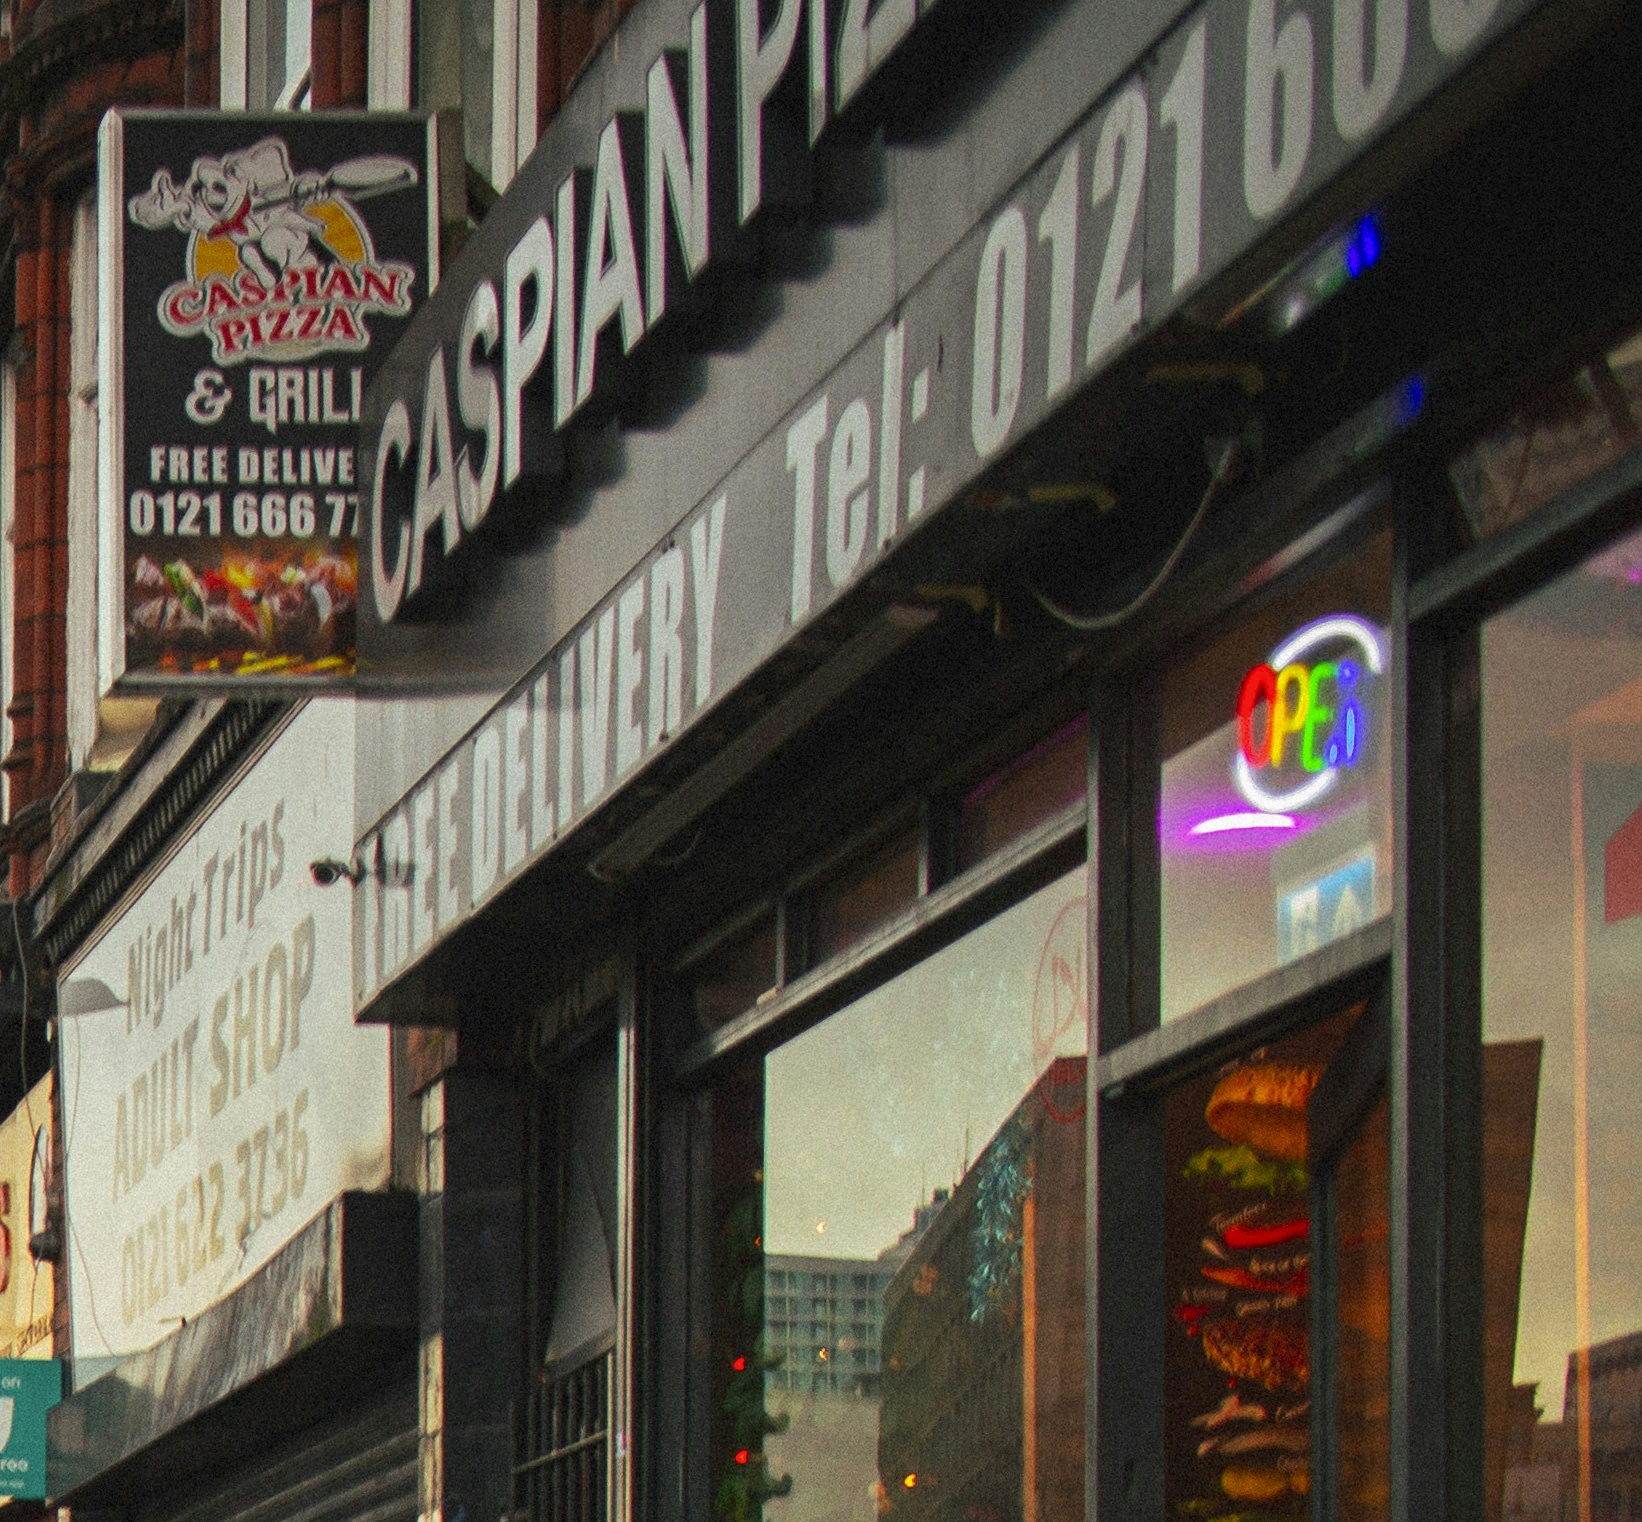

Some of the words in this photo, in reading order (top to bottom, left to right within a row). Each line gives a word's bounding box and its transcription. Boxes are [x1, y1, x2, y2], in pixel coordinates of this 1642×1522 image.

[167, 264, 402, 326] CASPIAN
[371, 1, 710, 624] CASPIAN
[217, 304, 361, 352] PIZZA
[185, 368, 232, 425] &
[150, 446, 228, 483] FREE
[238, 446, 354, 484] DELIVE
[130, 490, 222, 536] 0121
[233, 491, 315, 537] 666
[363, 758, 461, 998] FREE
[470, 492, 728, 908] DELIVERY
[785, 316, 929, 627] Tel:
[971, 15, 1207, 460] 0121
[126, 885, 197, 1034] Night
[202, 798, 285, 957] Trips
[115, 1013, 199, 1197] ADULT
[211, 912, 315, 1119] SHOP
[122, 1206, 169, 1327] 0121
[174, 1160, 226, 1287] 622
[234, 1087, 309, 1250] 3736
[1, 1376, 21, 1389] on
